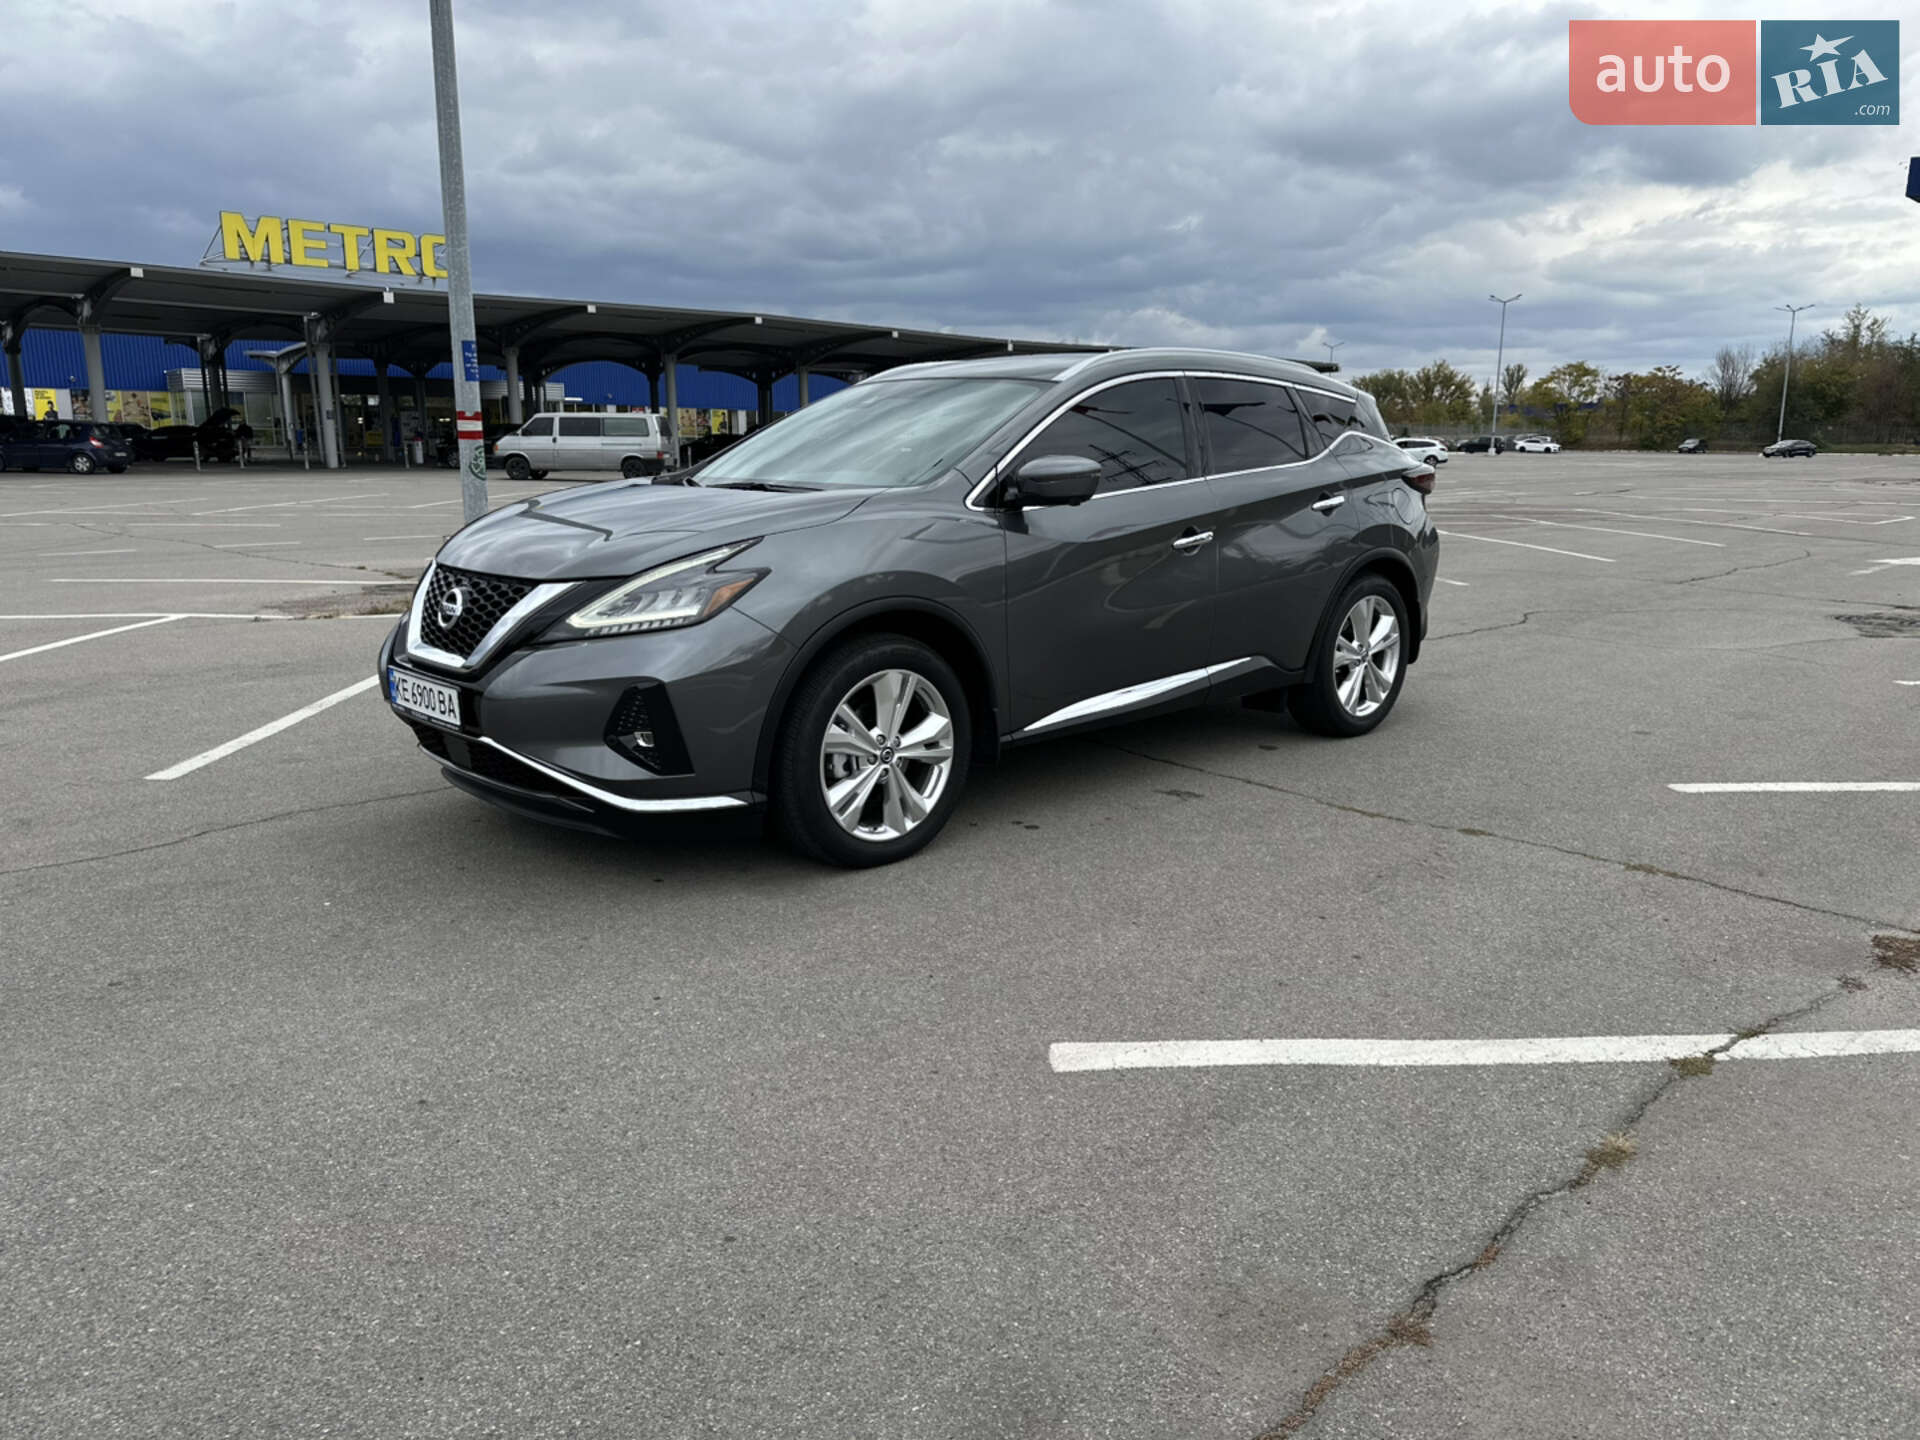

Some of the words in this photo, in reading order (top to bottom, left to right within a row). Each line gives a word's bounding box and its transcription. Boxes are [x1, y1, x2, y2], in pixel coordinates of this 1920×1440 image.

[396, 677, 410, 703] KE
[411, 682, 436, 711] 6900
[438, 690, 457, 719] BA
